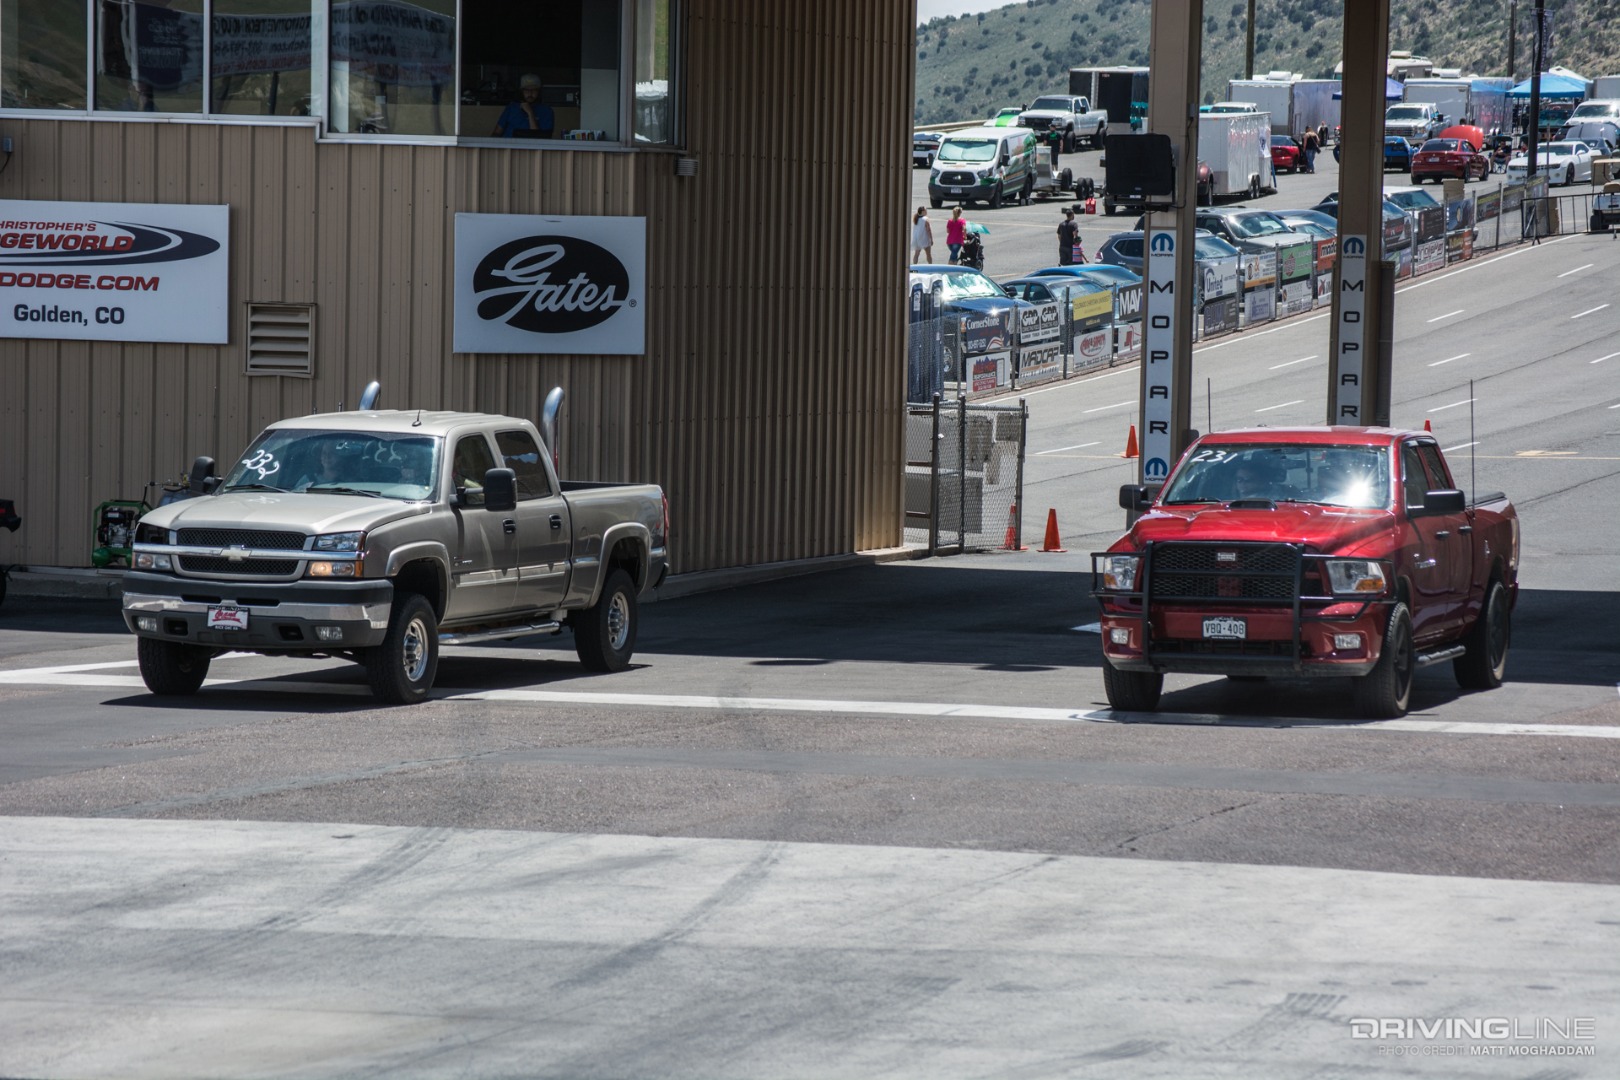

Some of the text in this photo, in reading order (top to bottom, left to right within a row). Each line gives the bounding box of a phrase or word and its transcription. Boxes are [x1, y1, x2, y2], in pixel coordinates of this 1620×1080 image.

[0, 232, 134, 251] GEWORLD
[0, 272, 160, 291] DODGE.COM
[475, 243, 627, 324] Gates
[13, 303, 125, 326] Golden, CO
[1021, 346, 1060, 368] MADCAP
[1149, 280, 1174, 435] MOPAR
[1341, 279, 1364, 418] MOPAR
[1190, 450, 1238, 464] 231
